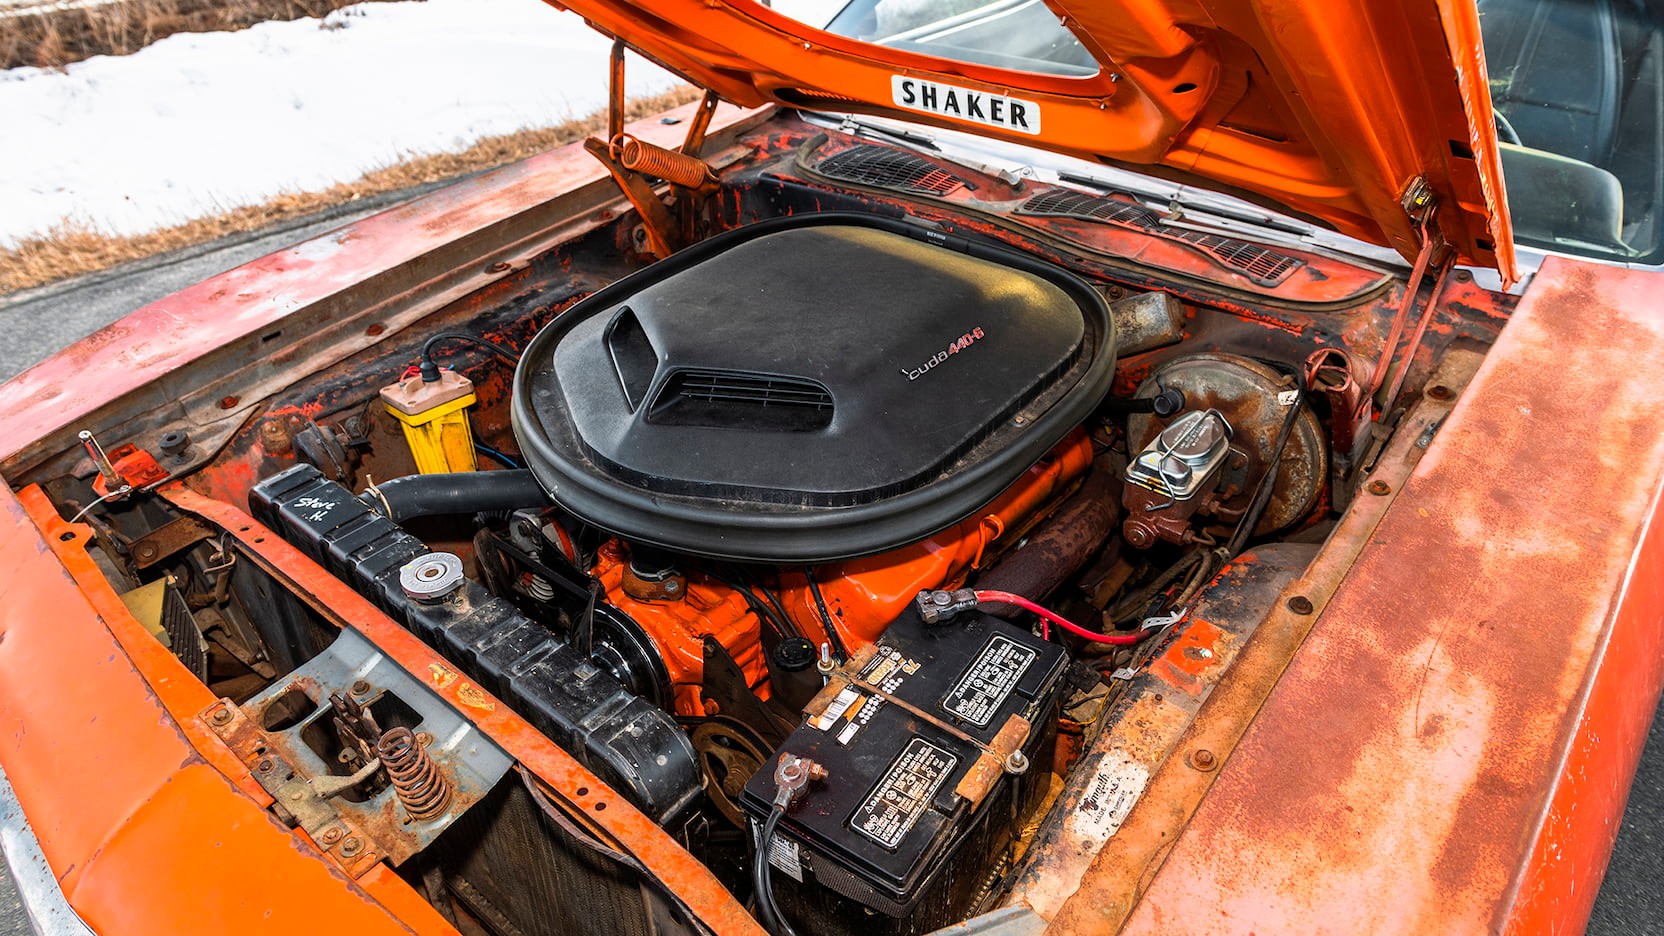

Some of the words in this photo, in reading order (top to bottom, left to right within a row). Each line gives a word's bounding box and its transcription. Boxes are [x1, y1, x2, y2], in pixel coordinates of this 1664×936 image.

[902, 81, 1029, 129] SHAKER
[294, 497, 336, 510] Steve
[902, 658, 921, 675] 75
